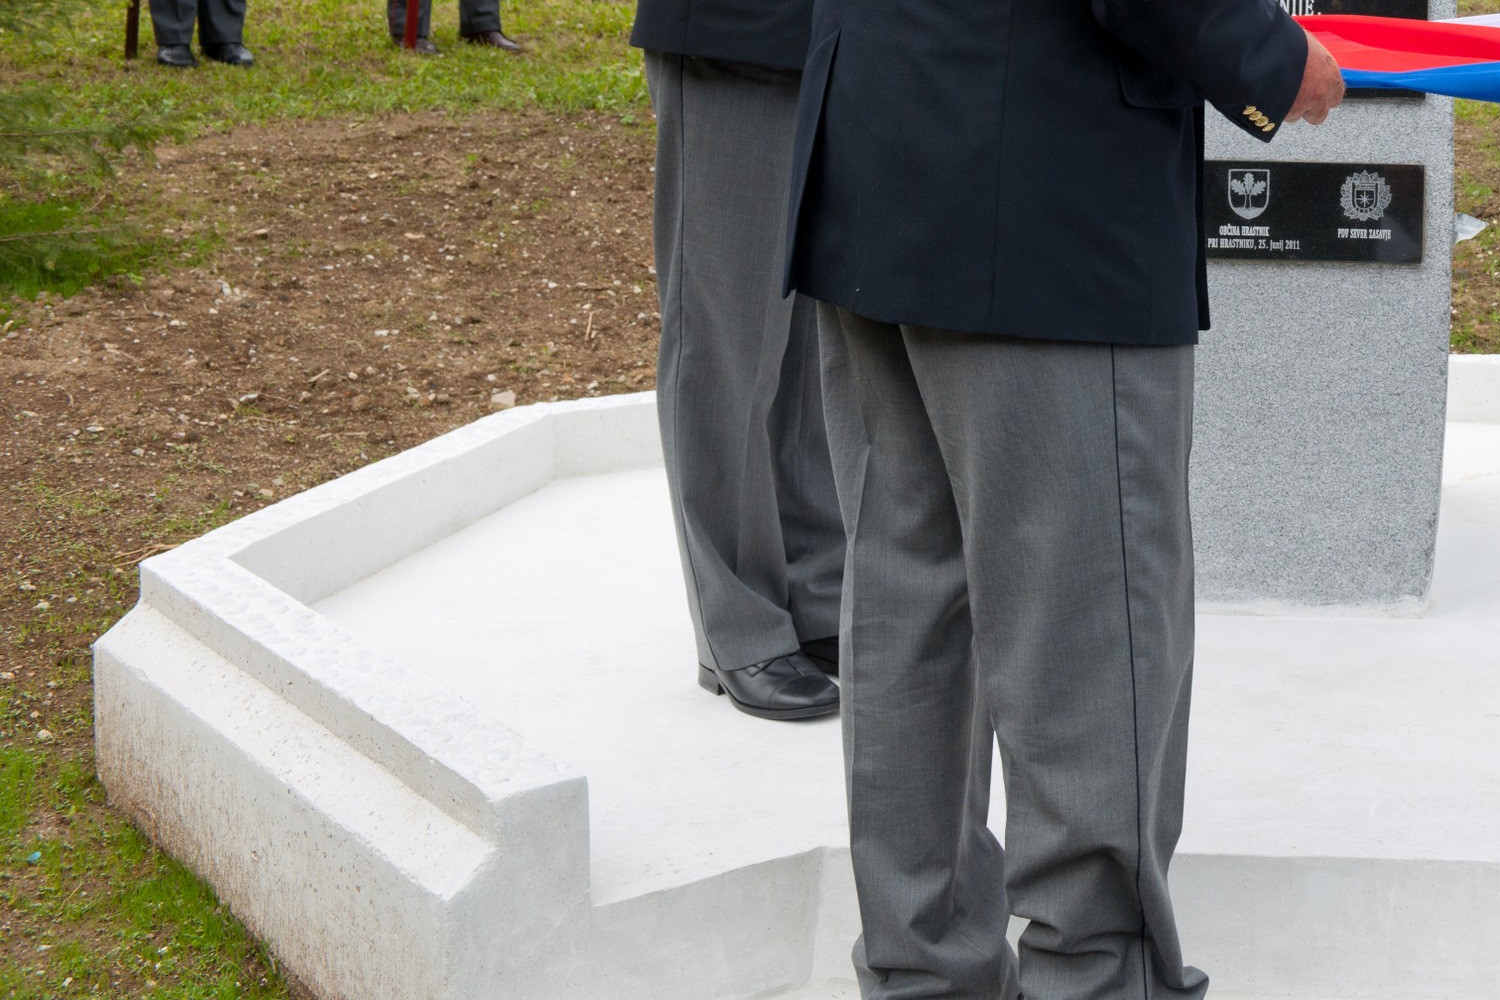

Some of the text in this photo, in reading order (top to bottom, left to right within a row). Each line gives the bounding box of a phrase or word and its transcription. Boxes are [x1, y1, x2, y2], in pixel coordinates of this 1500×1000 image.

[1219, 223, 1269, 236] OBČINA HRASTNIK
[1350, 228, 1368, 239] SEVER
[1369, 229, 1391, 241] ZASAVJE
[1207, 238, 1300, 252] PRI HRASTNIKU, 25. junij 2011
